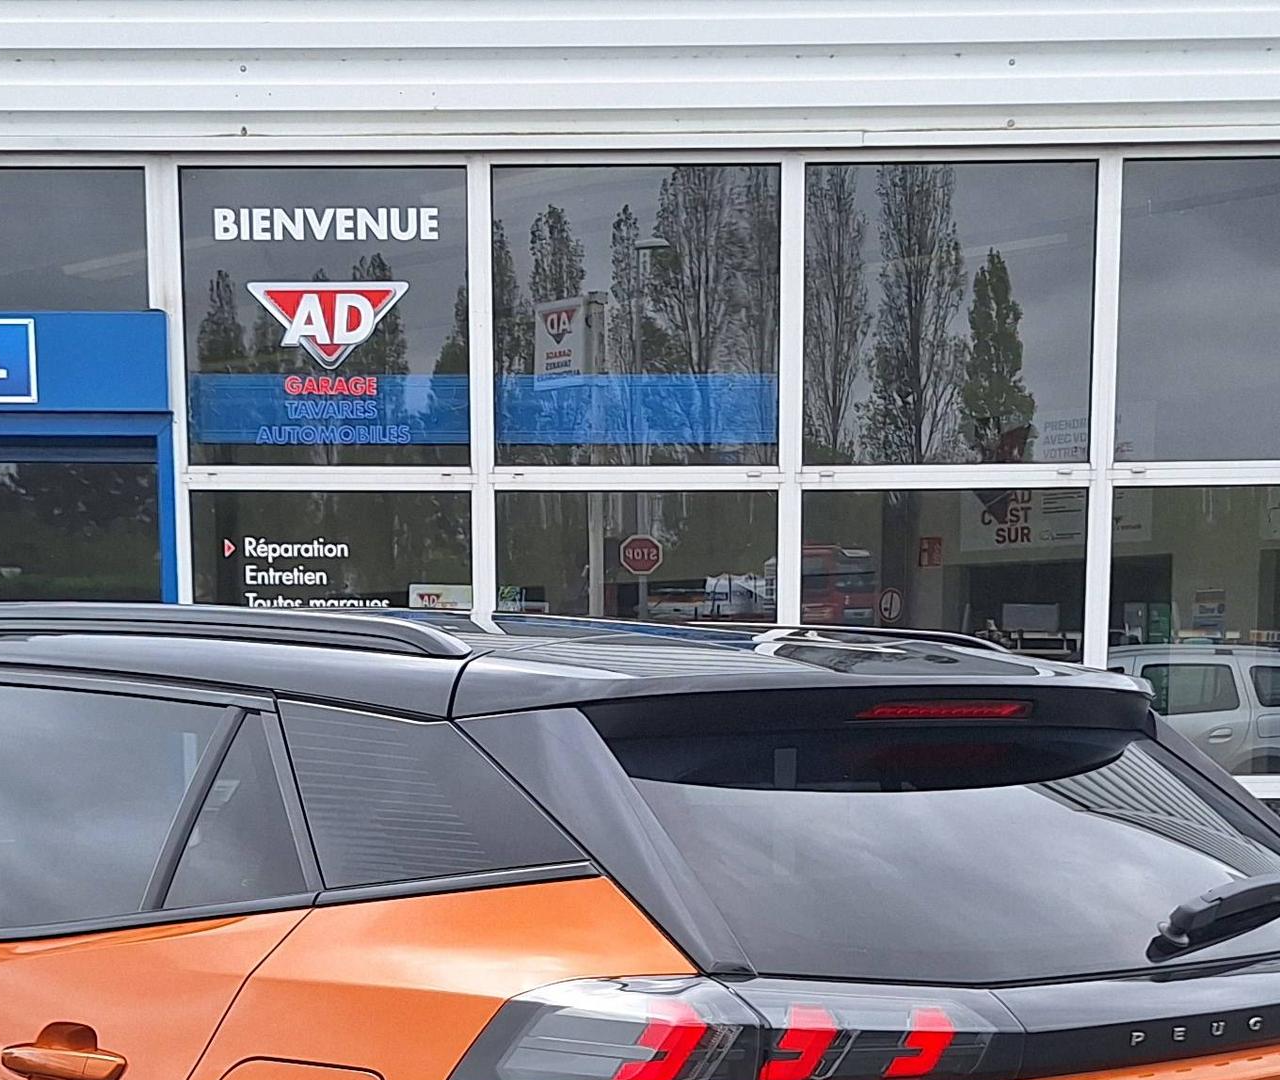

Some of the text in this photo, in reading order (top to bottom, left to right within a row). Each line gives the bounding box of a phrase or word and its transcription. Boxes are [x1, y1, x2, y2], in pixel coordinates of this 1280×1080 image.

[214, 206, 440, 242] BIENVENUE
[281, 293, 377, 347] AD
[284, 375, 378, 397] GARAGE
[285, 399, 378, 420] TAVARES
[256, 424, 411, 445] AUTOMOBILES
[244, 536, 349, 562] Réparation
[245, 565, 328, 586] Entretien
